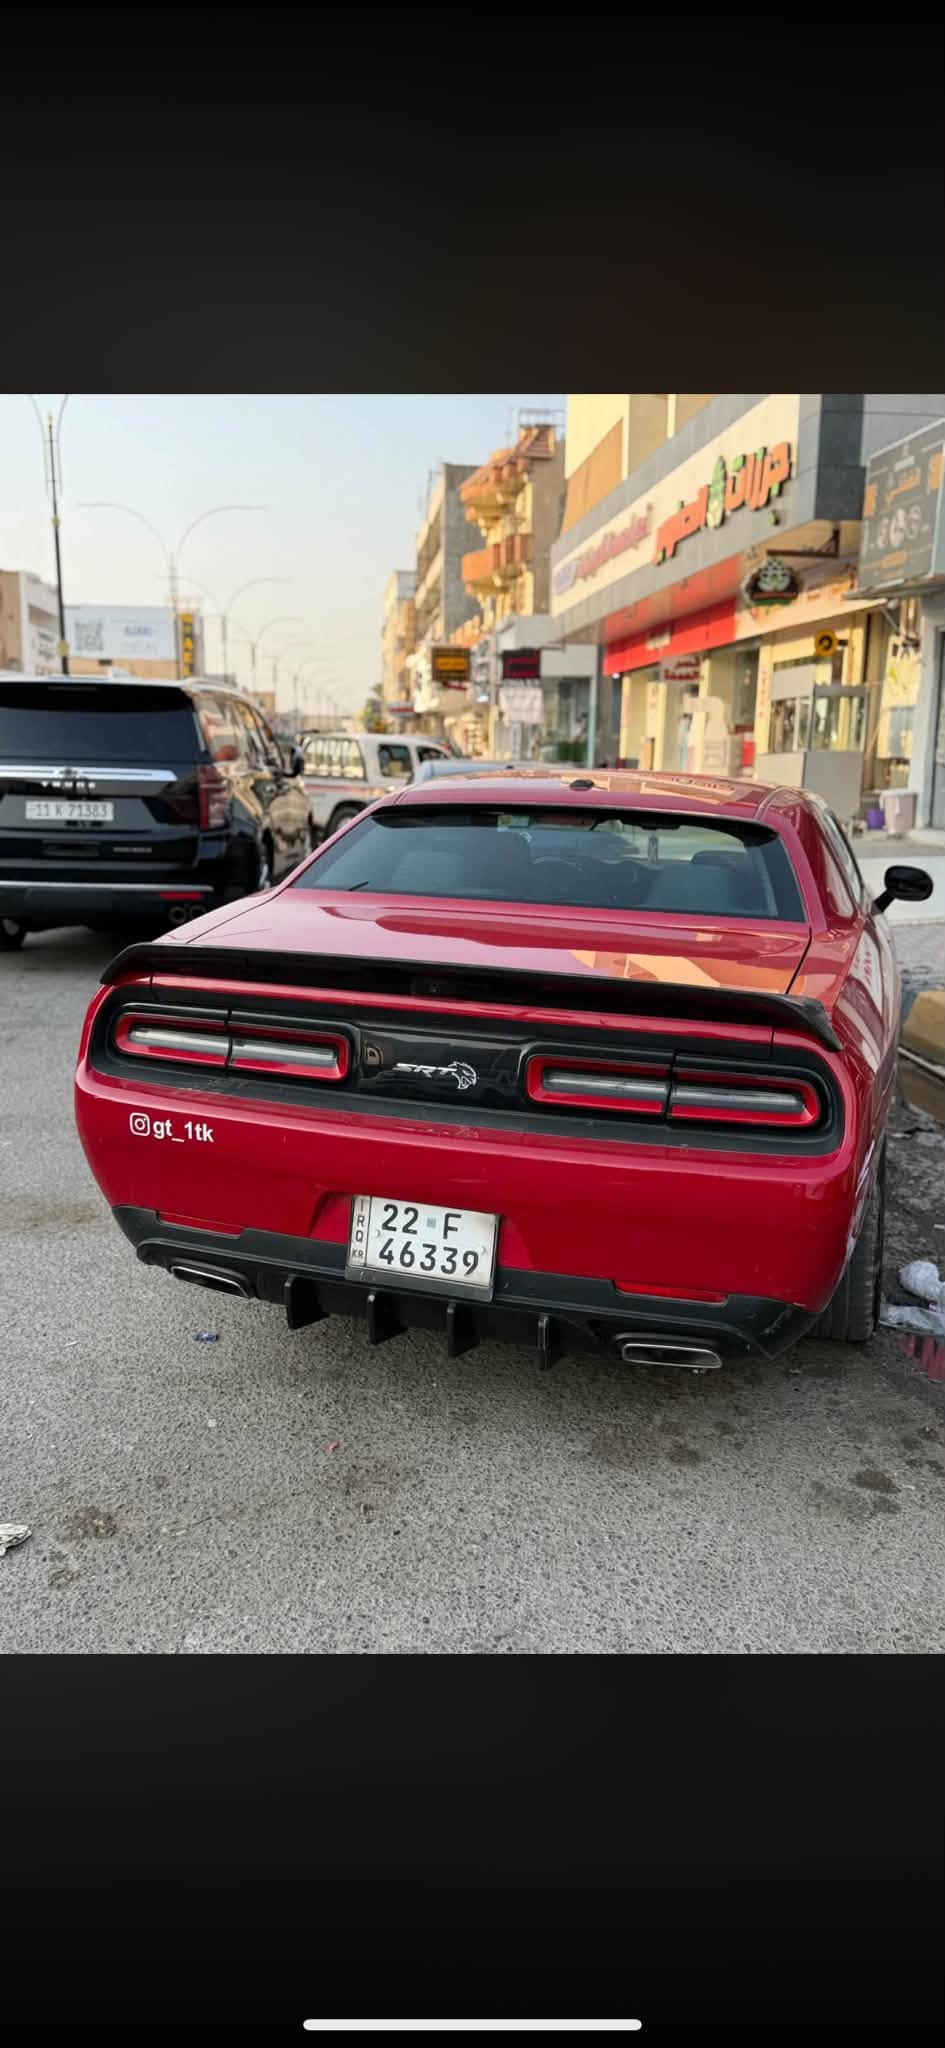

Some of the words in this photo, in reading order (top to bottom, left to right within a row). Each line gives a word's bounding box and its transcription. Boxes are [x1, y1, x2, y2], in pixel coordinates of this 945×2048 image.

[152, 1118, 215, 1143] gt_1tk
[381, 1203, 419, 1235] 22
[442, 1212, 463, 1240] F
[378, 1237, 480, 1277] 46339
